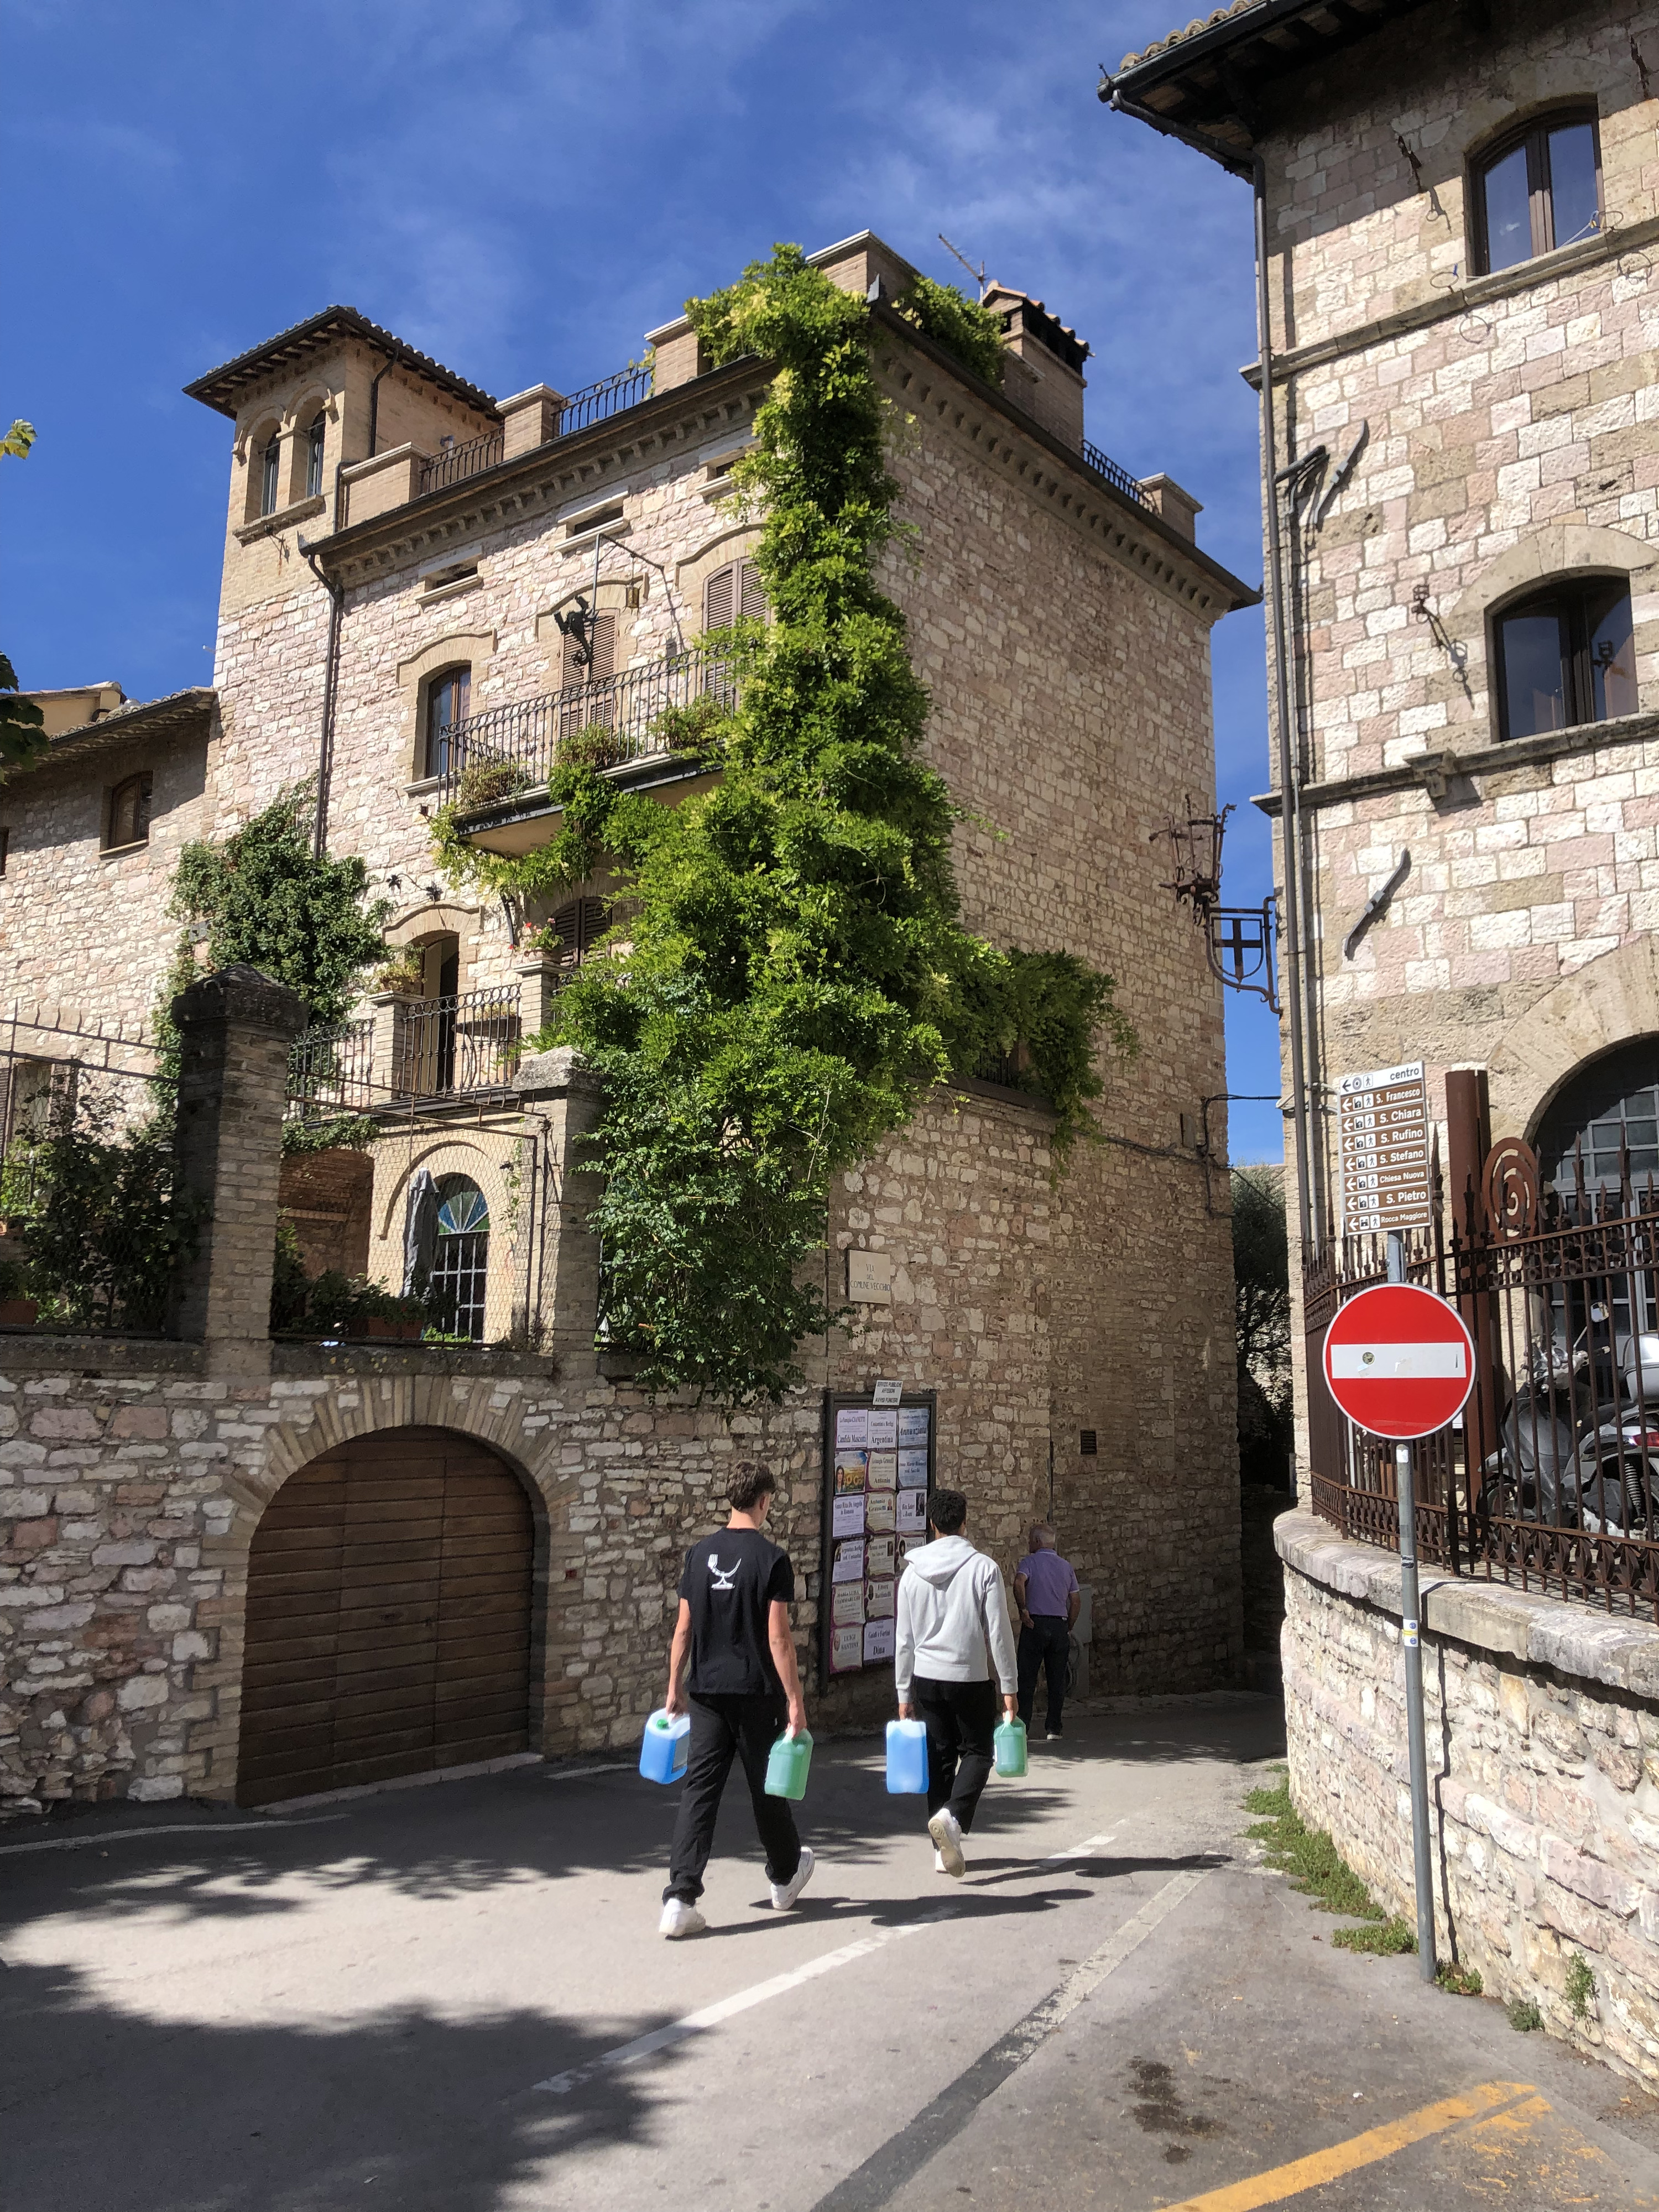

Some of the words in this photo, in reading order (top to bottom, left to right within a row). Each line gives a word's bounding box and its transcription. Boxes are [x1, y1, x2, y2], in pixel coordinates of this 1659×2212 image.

[1390, 1067, 1420, 1081] centro
[1376, 1093, 1384, 1104] S.
[1386, 1088, 1421, 1102] Francesco
[1380, 1113, 1389, 1124] S.
[1391, 1108, 1422, 1121] Chiara
[1380, 1133, 1390, 1144] S.
[1392, 1128, 1423, 1141] Rufino
[1379, 1154, 1389, 1164] S.
[1390, 1150, 1424, 1162] Stefano
[1380, 1175, 1402, 1183] Chiesa
[1402, 1171, 1425, 1180] Nuova
[1386, 1193, 1396, 1204] S.
[1398, 1190, 1427, 1203] Pietro
[1400, 1212, 1427, 1222] Maggiore
[866, 1264, 874, 1272] VIA
[850, 1280, 869, 1290] COMUNE
[870, 1282, 891, 1291] VECCHIO
[871, 1435, 893, 1445] Argentina
[873, 1646, 885, 1655] Dina
